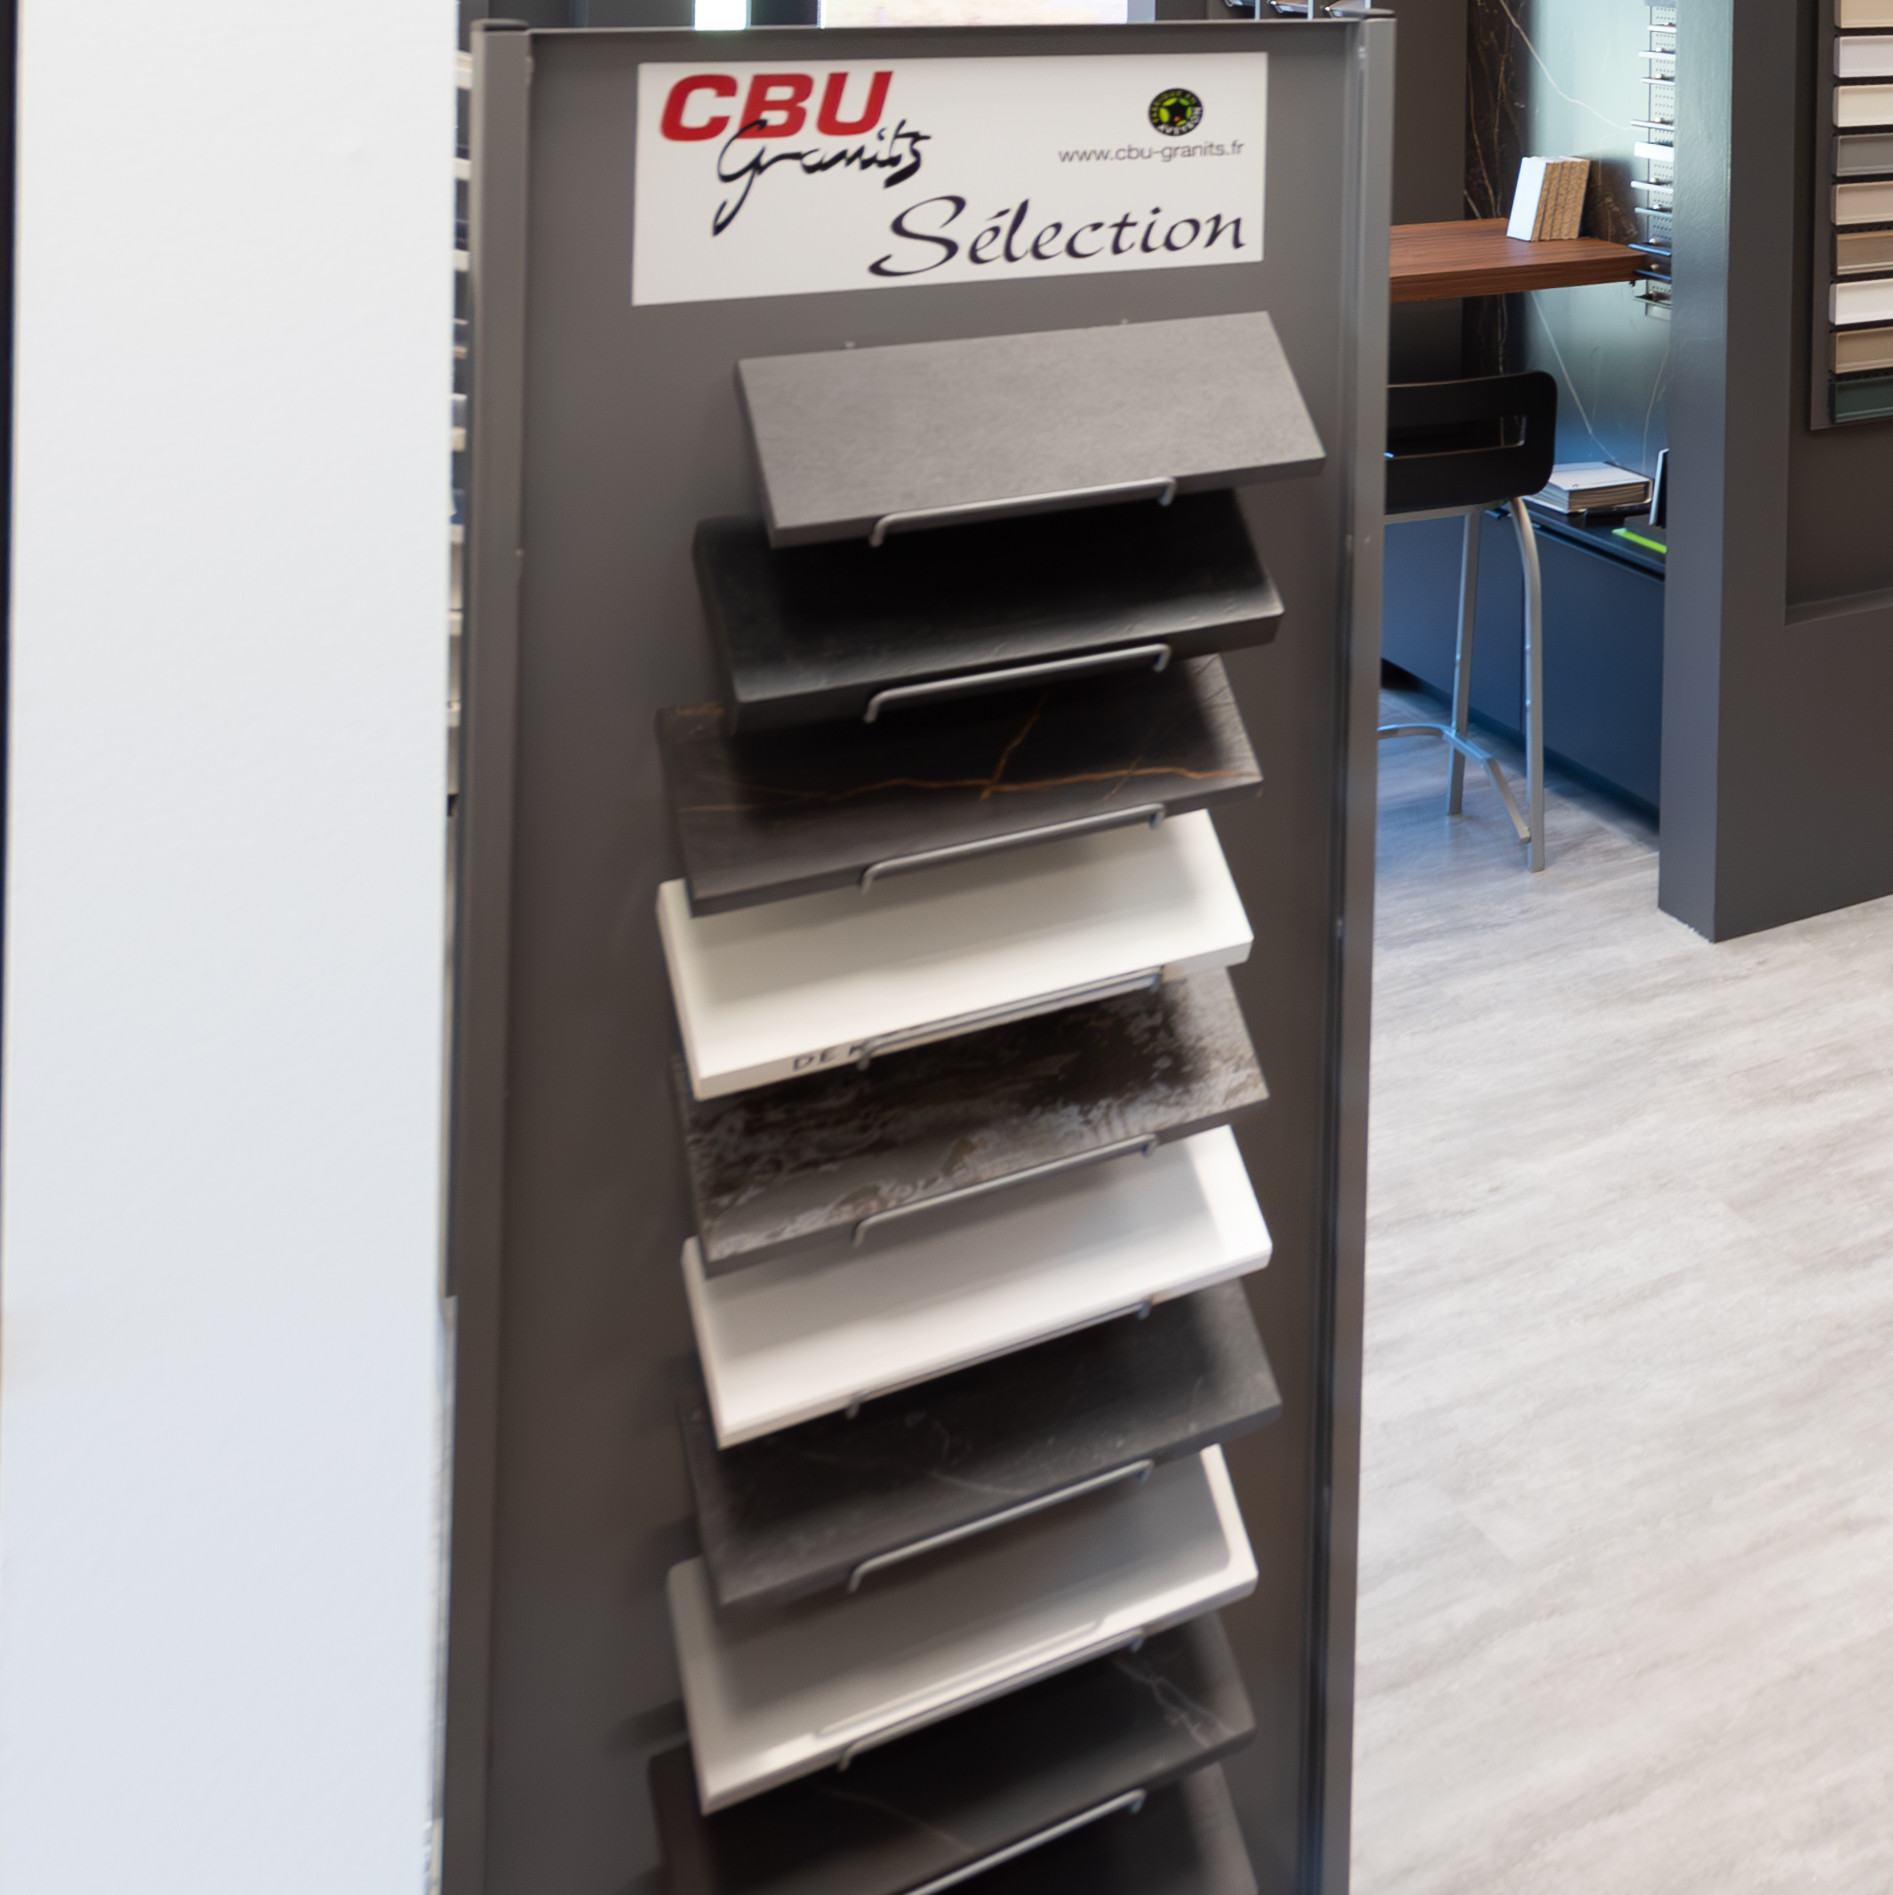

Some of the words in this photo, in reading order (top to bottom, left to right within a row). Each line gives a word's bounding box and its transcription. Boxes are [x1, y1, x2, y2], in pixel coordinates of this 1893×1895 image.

[660, 71, 893, 142] CBU
[713, 119, 930, 236] Granits
[1058, 139, 1245, 163] www.cbu-granits.fr
[868, 195, 1247, 277] Sélection
